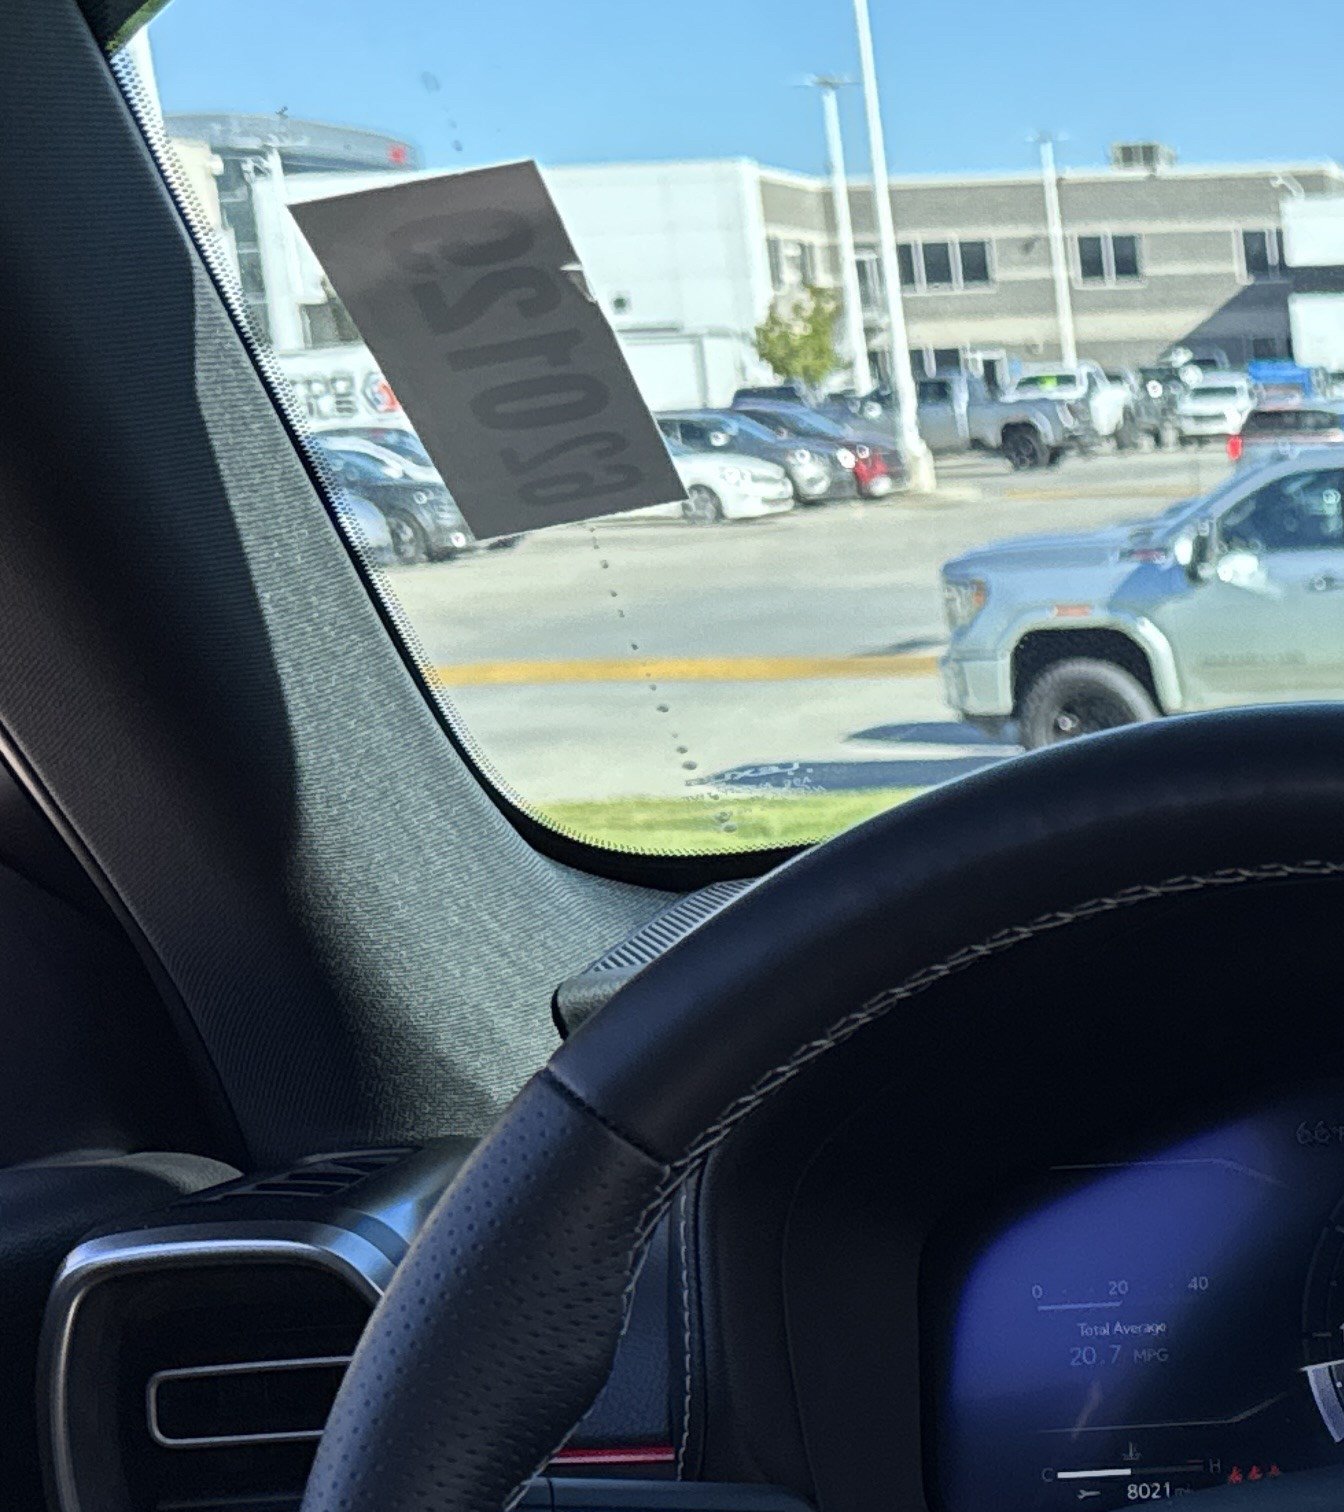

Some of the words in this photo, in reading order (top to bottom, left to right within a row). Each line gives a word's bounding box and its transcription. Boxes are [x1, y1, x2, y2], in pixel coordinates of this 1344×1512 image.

[1031, 1284, 1043, 1299] 0
[1108, 1279, 1129, 1296] 20
[1187, 1275, 1209, 1292] 40
[1076, 1322, 1110, 1338] Total
[1113, 1320, 1167, 1338] Average
[1133, 1346, 1169, 1364] MPG
[1208, 1457, 1222, 1474] H
[1041, 1467, 1054, 1483] C
[1126, 1481, 1172, 1500] 8021
